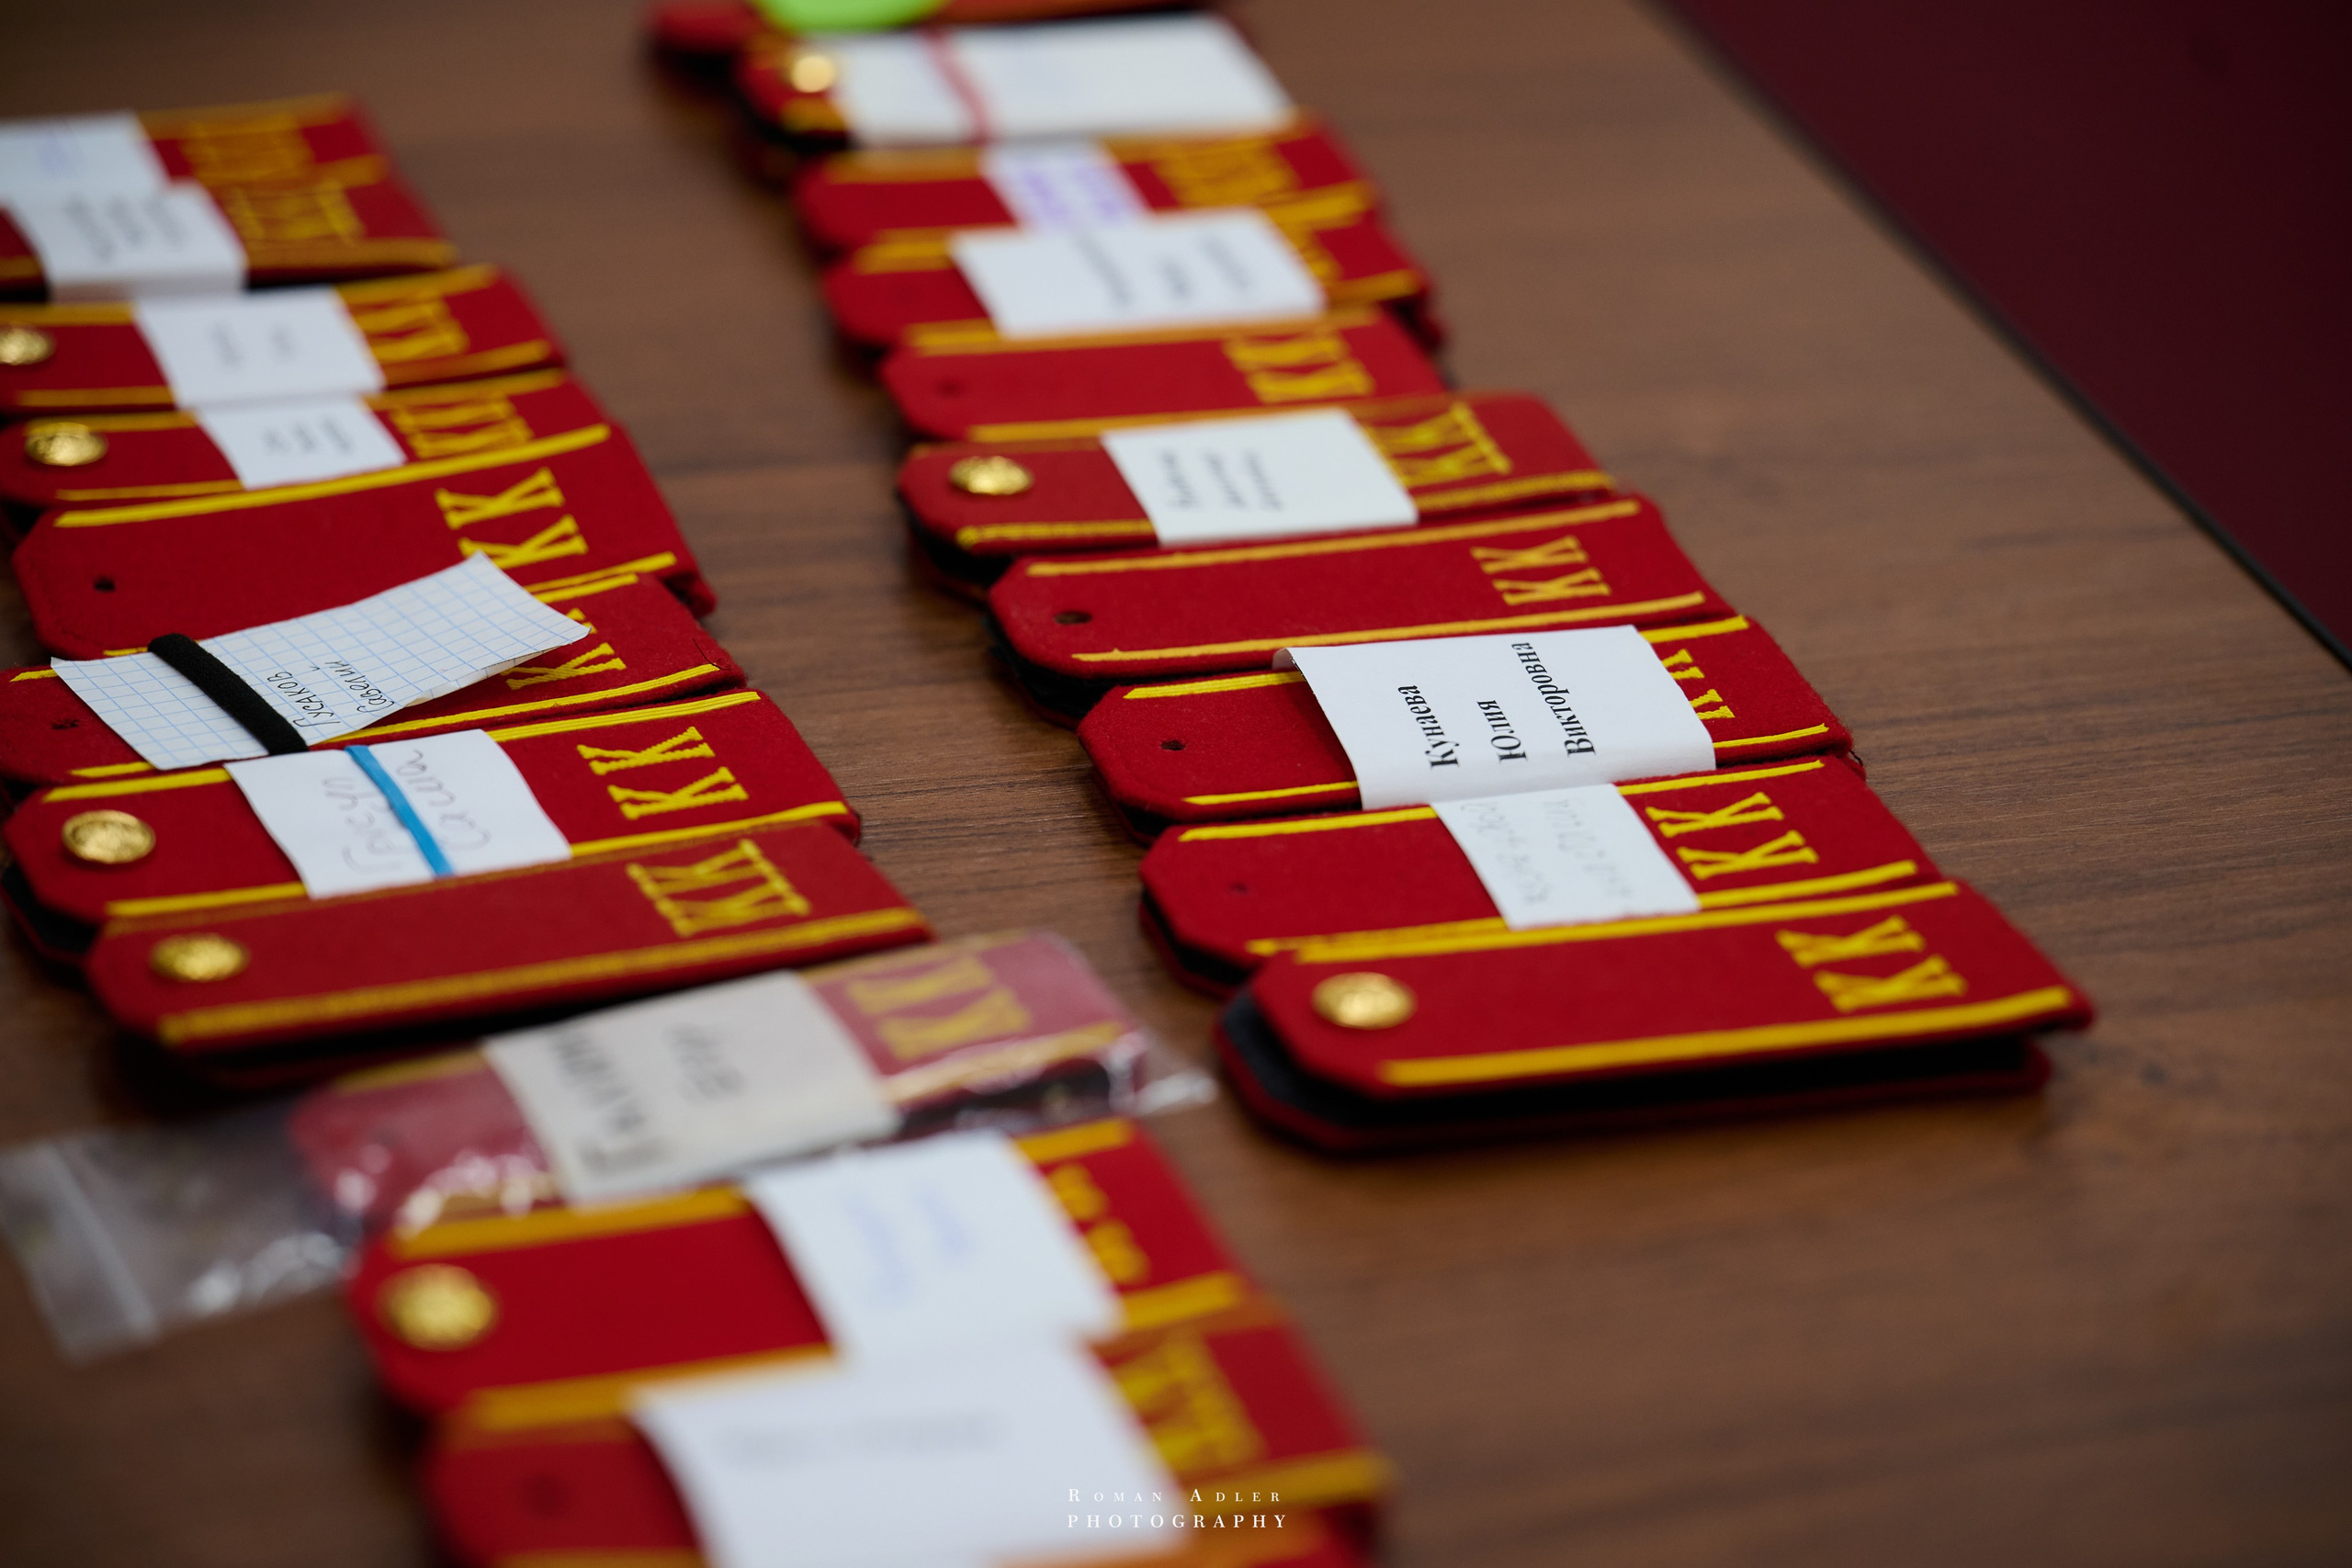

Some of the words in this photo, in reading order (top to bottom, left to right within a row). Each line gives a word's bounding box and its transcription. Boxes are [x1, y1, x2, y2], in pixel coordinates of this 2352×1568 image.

[1397, 684, 1460, 770] Кунаева
[1476, 699, 1529, 764] Юлия
[1511, 642, 1597, 758] Викторовна
